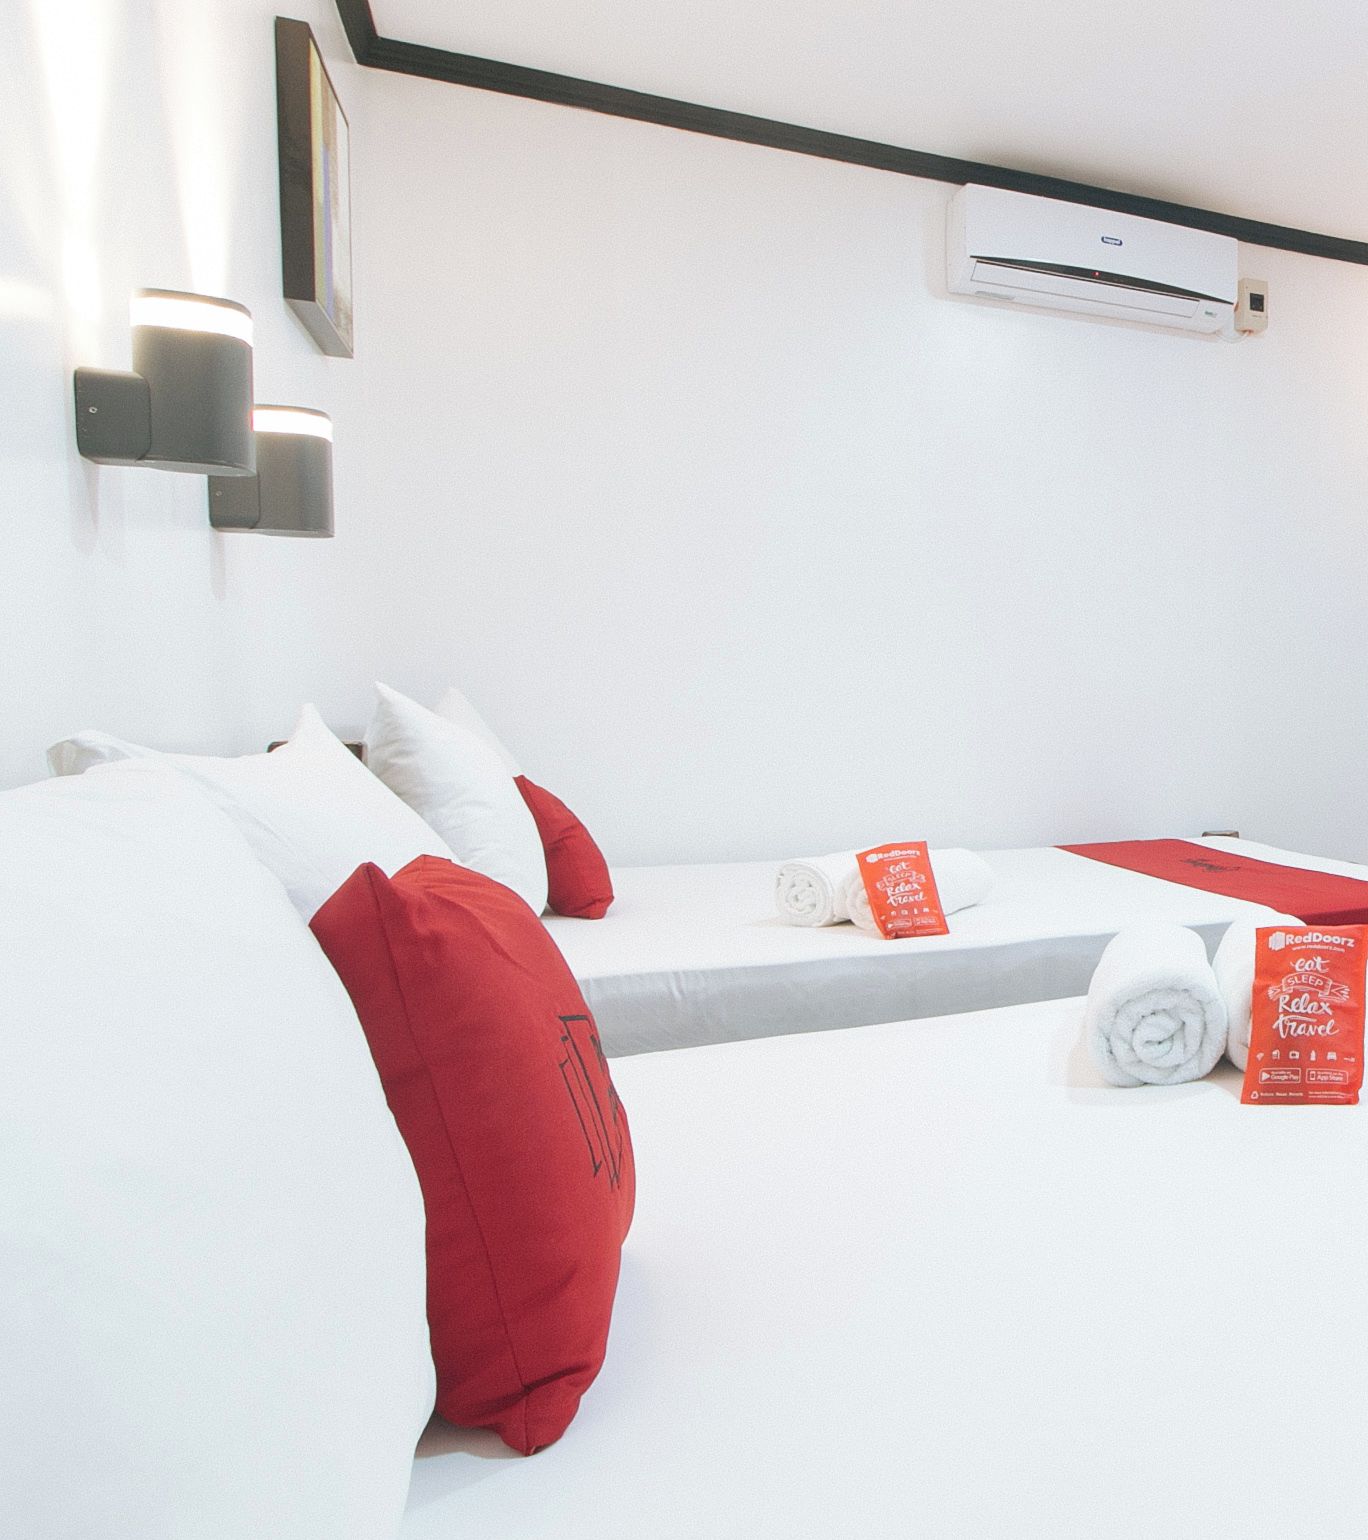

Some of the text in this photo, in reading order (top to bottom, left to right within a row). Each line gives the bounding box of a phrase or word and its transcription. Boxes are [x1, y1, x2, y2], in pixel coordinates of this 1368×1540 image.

[1286, 932, 1355, 947] RedDoorz
[1290, 956, 1330, 973] eat
[1287, 974, 1324, 987] SLEEP
[1278, 993, 1333, 1015] Relax
